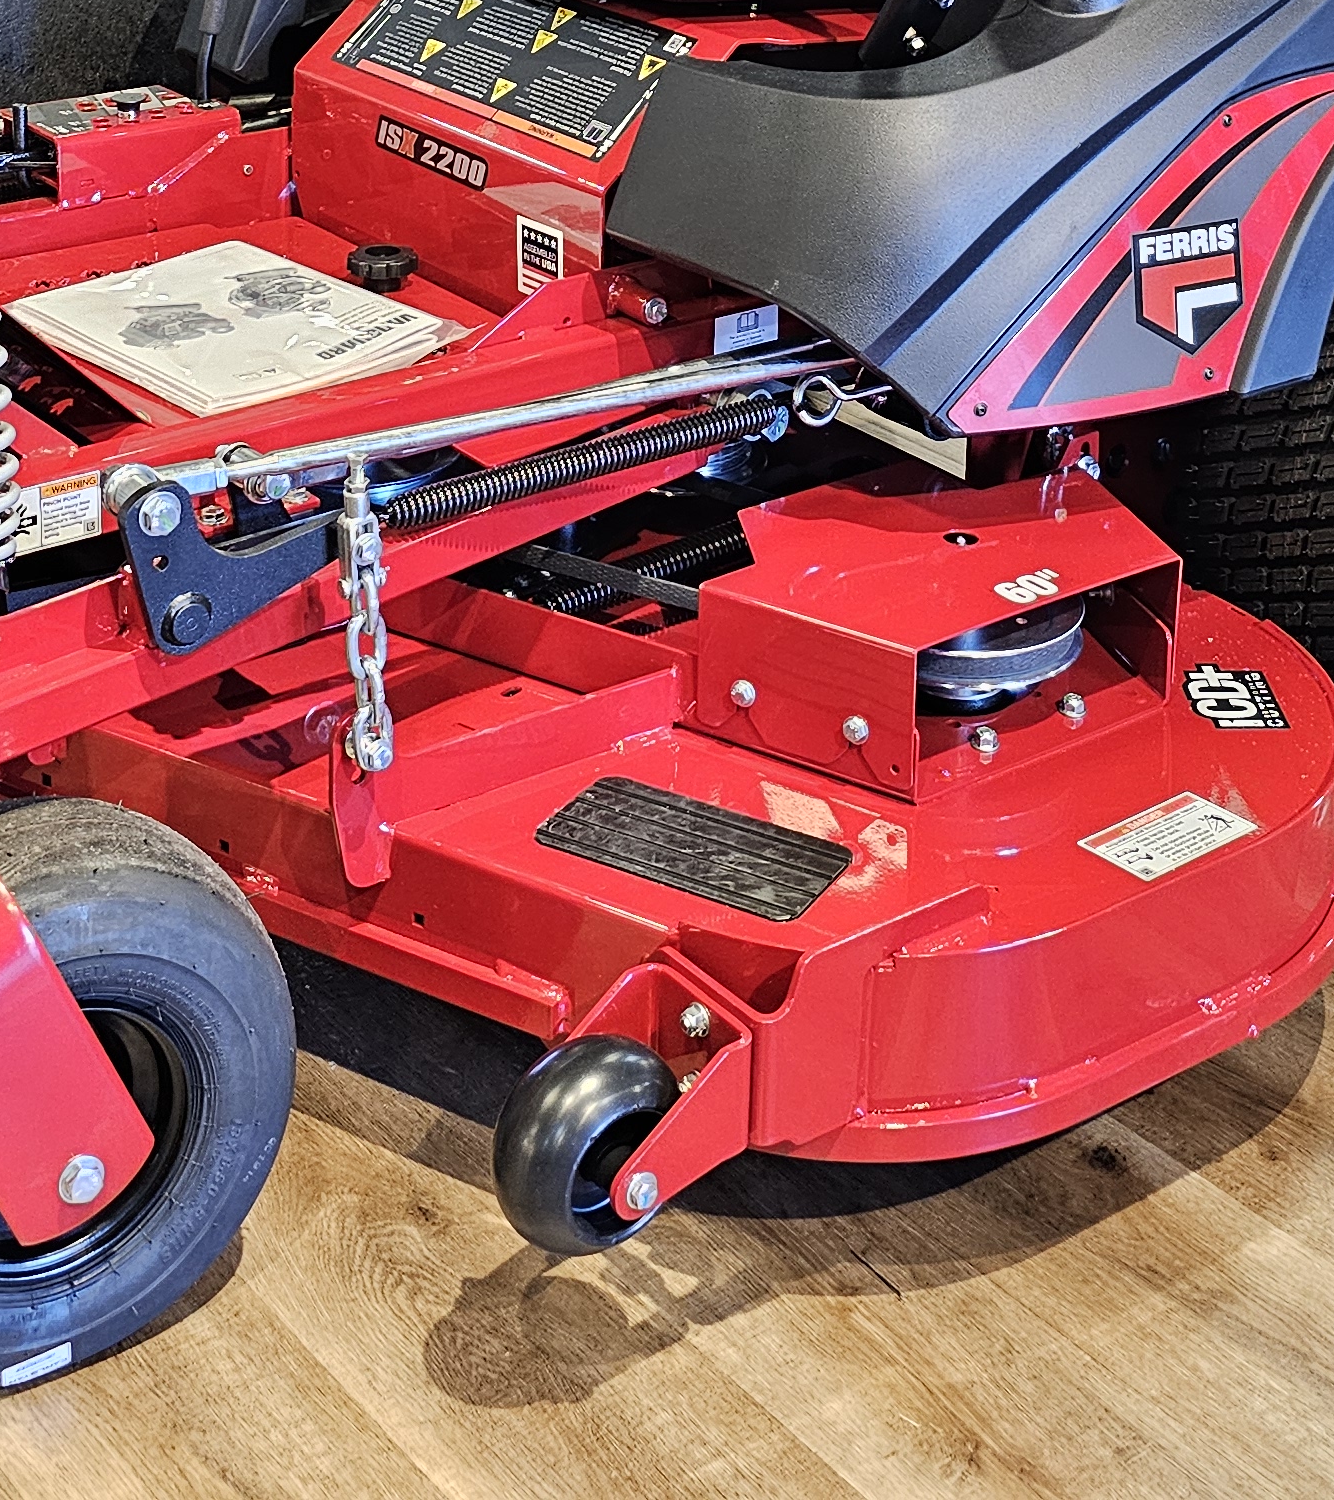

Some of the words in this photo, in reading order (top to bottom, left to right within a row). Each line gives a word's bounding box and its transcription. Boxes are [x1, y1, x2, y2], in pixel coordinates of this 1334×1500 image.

[378, 119, 416, 158] ISX
[420, 138, 487, 187] 2200
[523, 243, 556, 261] ASSEMBLED
[1139, 223, 1235, 263] FERRIS
[541, 259, 556, 272] USA
[51, 476, 96, 495] WARNING
[1127, 809, 1166, 829] DANGER
